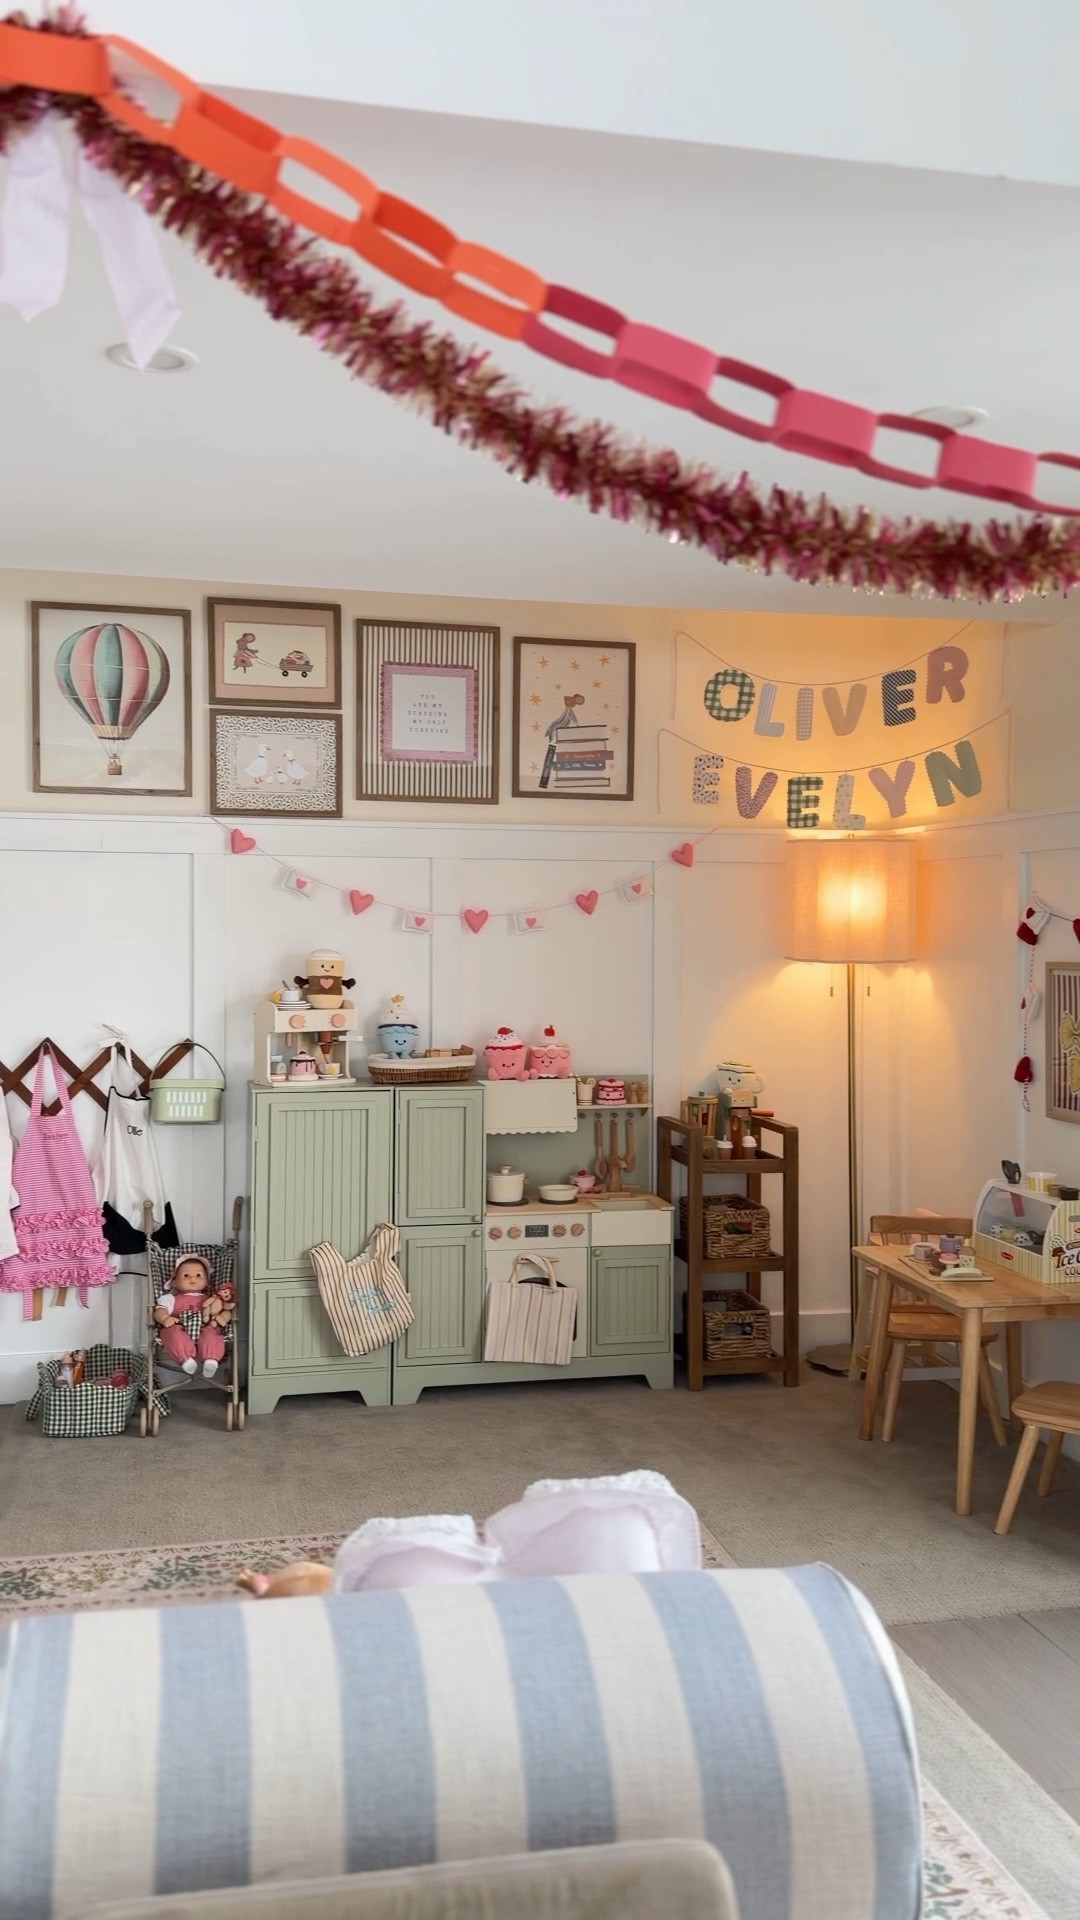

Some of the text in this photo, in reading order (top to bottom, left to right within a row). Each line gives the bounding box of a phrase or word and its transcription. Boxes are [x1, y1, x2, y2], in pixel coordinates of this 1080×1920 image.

[704, 646, 969, 741] OLIVER
[692, 740, 983, 830] EVELYN
[1055, 1252, 1075, 1269] Ice
